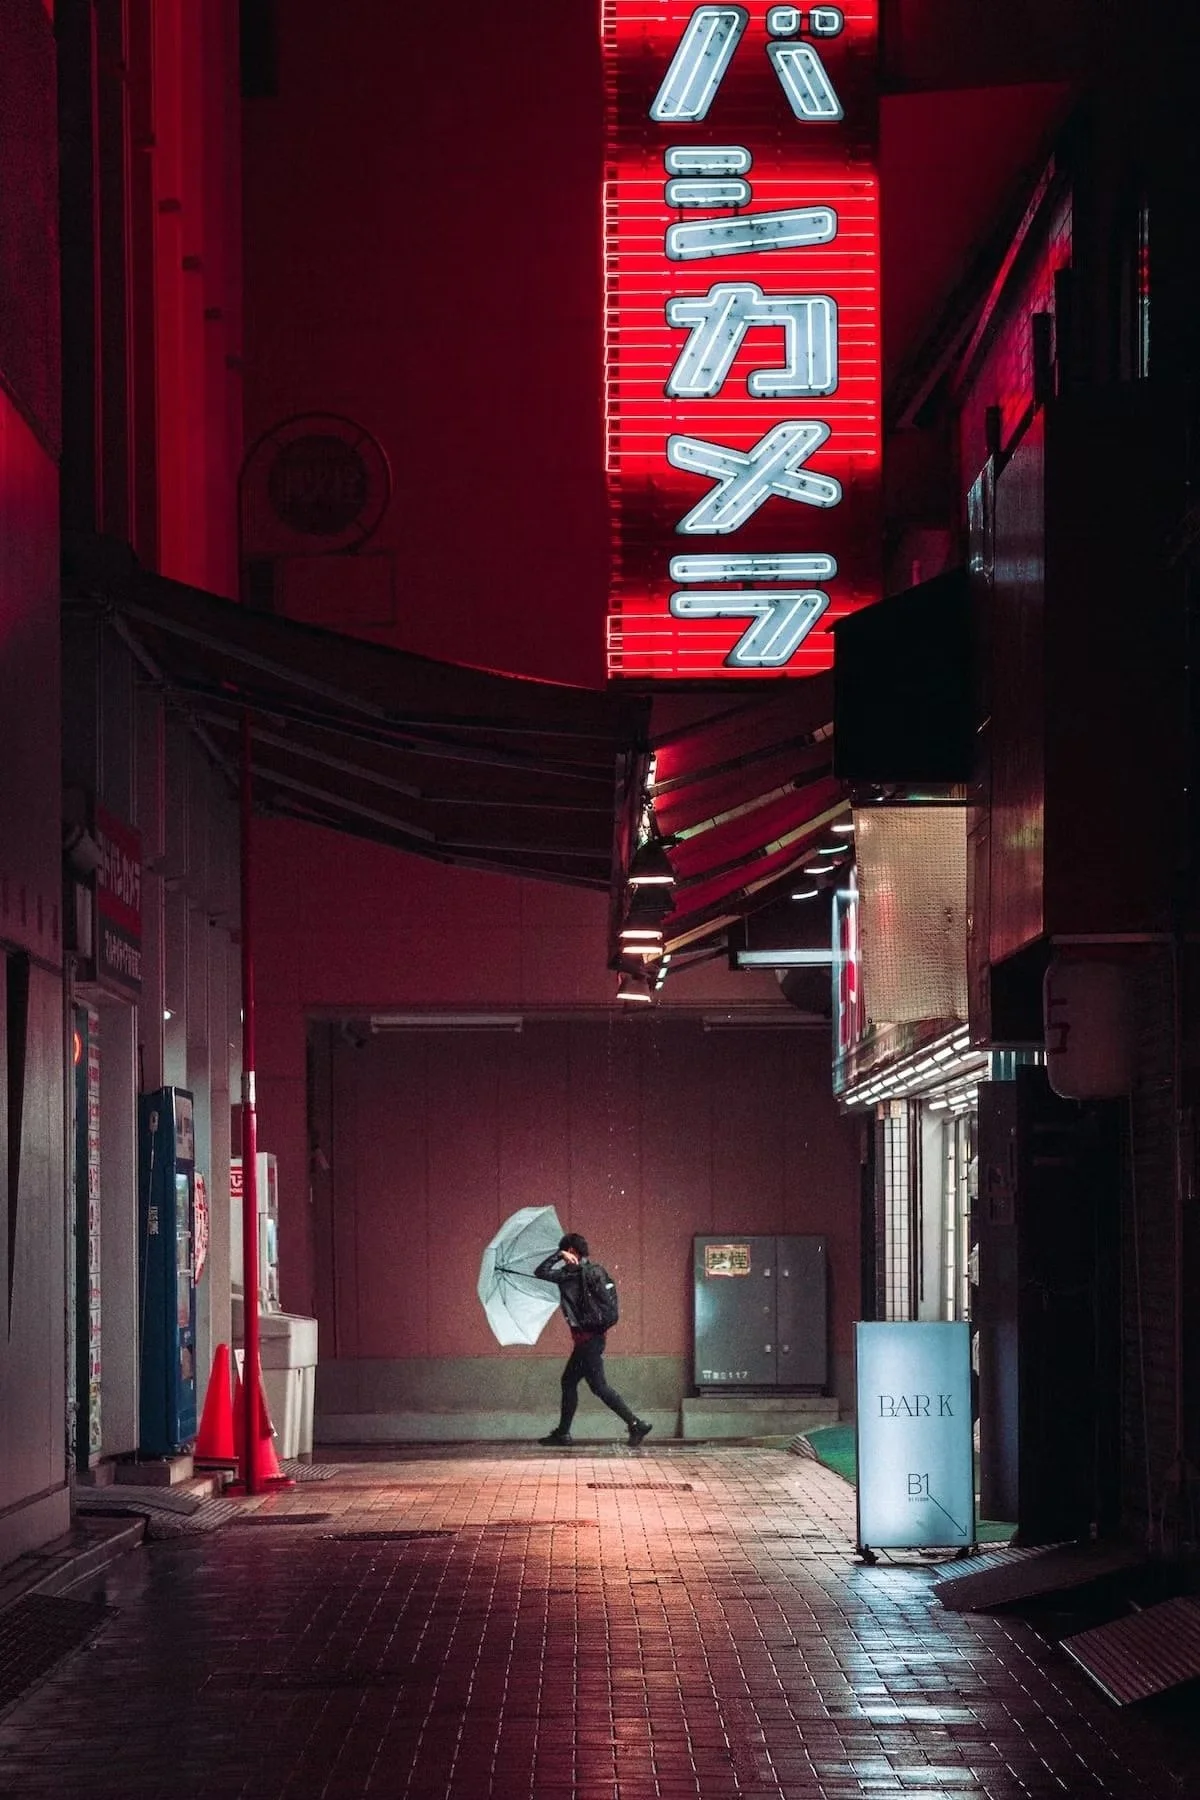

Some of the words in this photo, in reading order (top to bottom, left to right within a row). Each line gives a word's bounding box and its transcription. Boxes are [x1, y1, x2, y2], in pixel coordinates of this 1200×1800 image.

[650, 4, 845, 668] バシカメラ
[878, 1394, 931, 1417] BAR
[937, 1394, 955, 1417] K
[908, 1473, 929, 1495] B1
